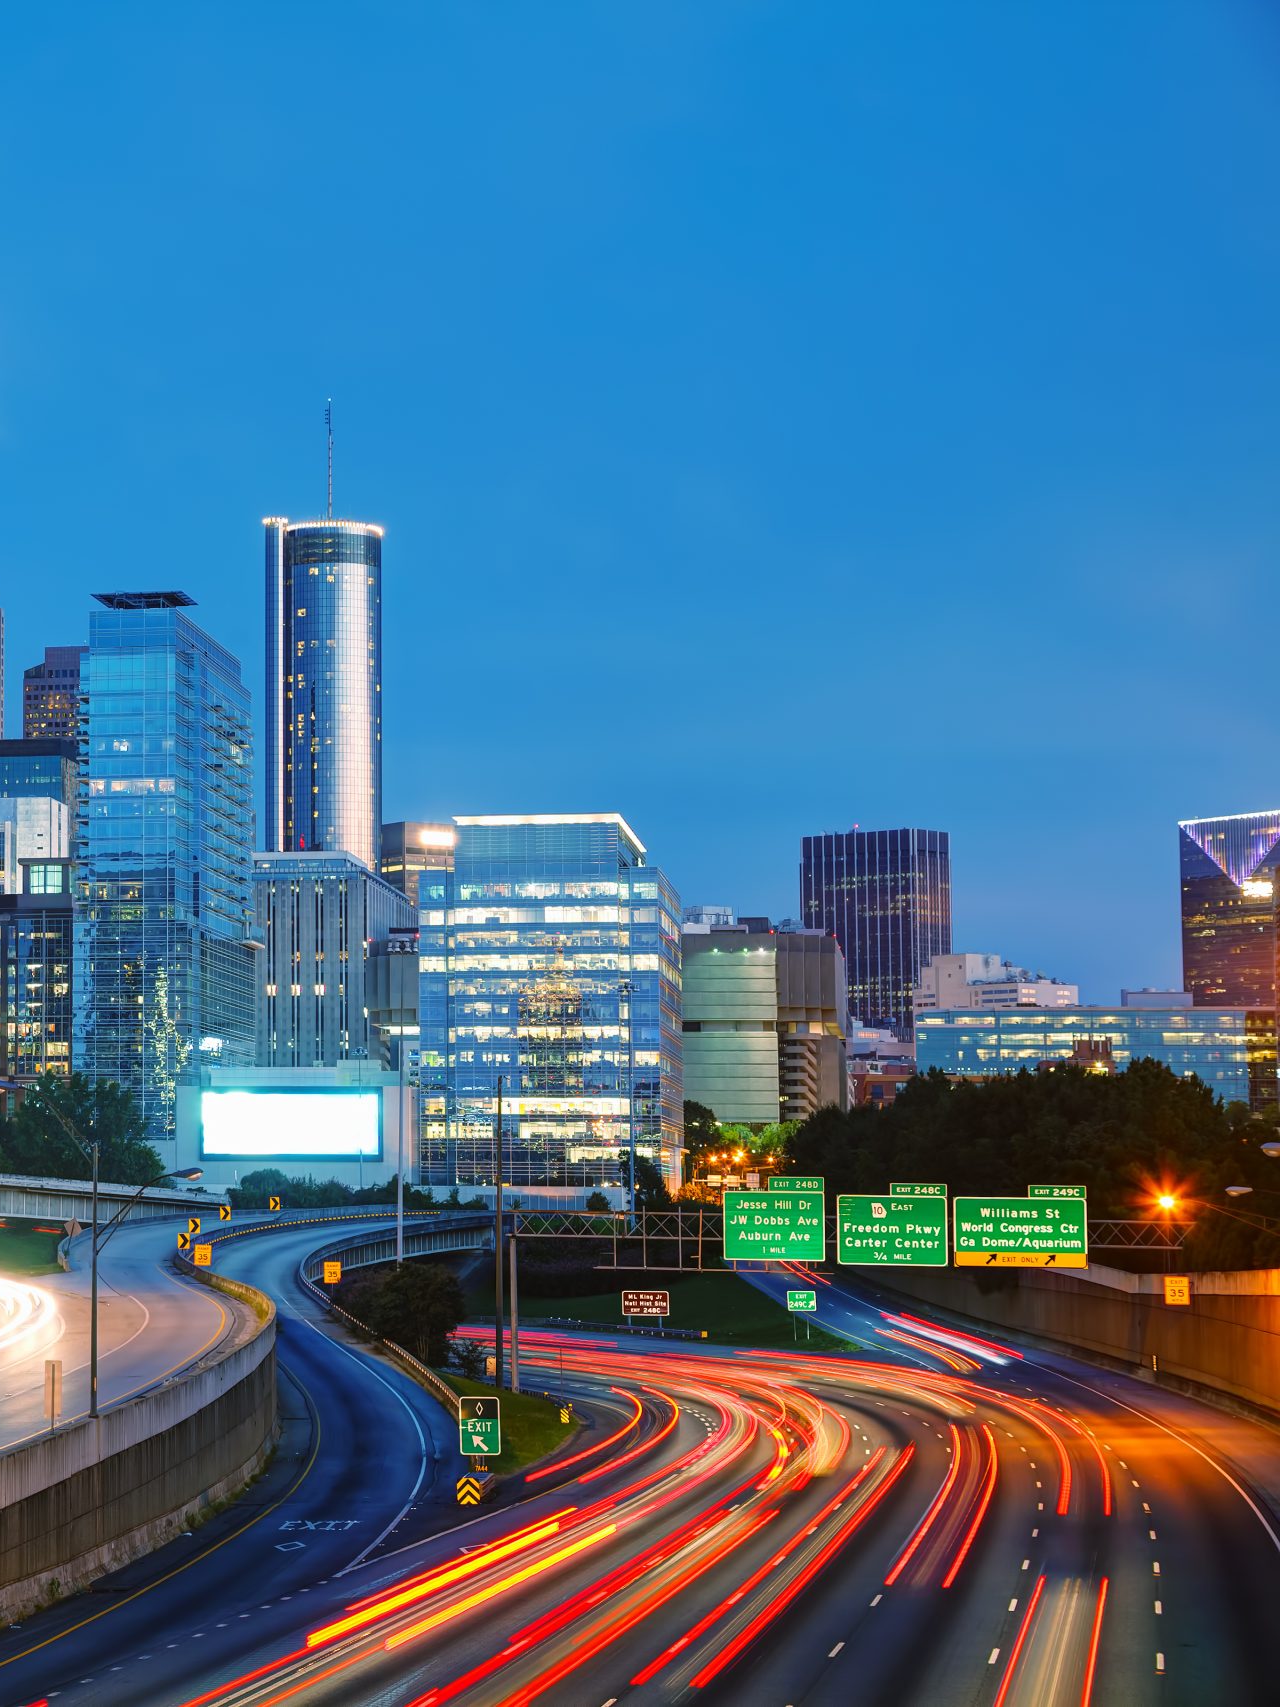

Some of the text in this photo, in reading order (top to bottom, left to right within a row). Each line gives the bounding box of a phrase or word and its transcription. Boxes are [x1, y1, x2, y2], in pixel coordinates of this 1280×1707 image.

[914, 1186, 940, 1194] 248C
[1052, 1188, 1080, 1196] 249C
[736, 1200, 812, 1210] Jesse Hill Dr
[891, 1203, 914, 1211] EAST
[873, 1206, 884, 1215] 10
[980, 1208, 1060, 1218] Williams St
[730, 1215, 818, 1226] JW Dobbs Ave
[843, 1222, 941, 1236] Freedom Pkwy
[961, 1222, 1079, 1235] World Congress Ctr
[738, 1231, 810, 1241] Auburn Ave
[845, 1237, 940, 1248] Carter Center
[960, 1236, 1082, 1250] Ga Dome/Aquarium
[328, 1270, 338, 1278] 35
[1170, 1288, 1184, 1298] 35
[789, 1300, 807, 1308] 249C
[468, 1422, 492, 1432] EXIT
[278, 1520, 362, 1530] EXIT
